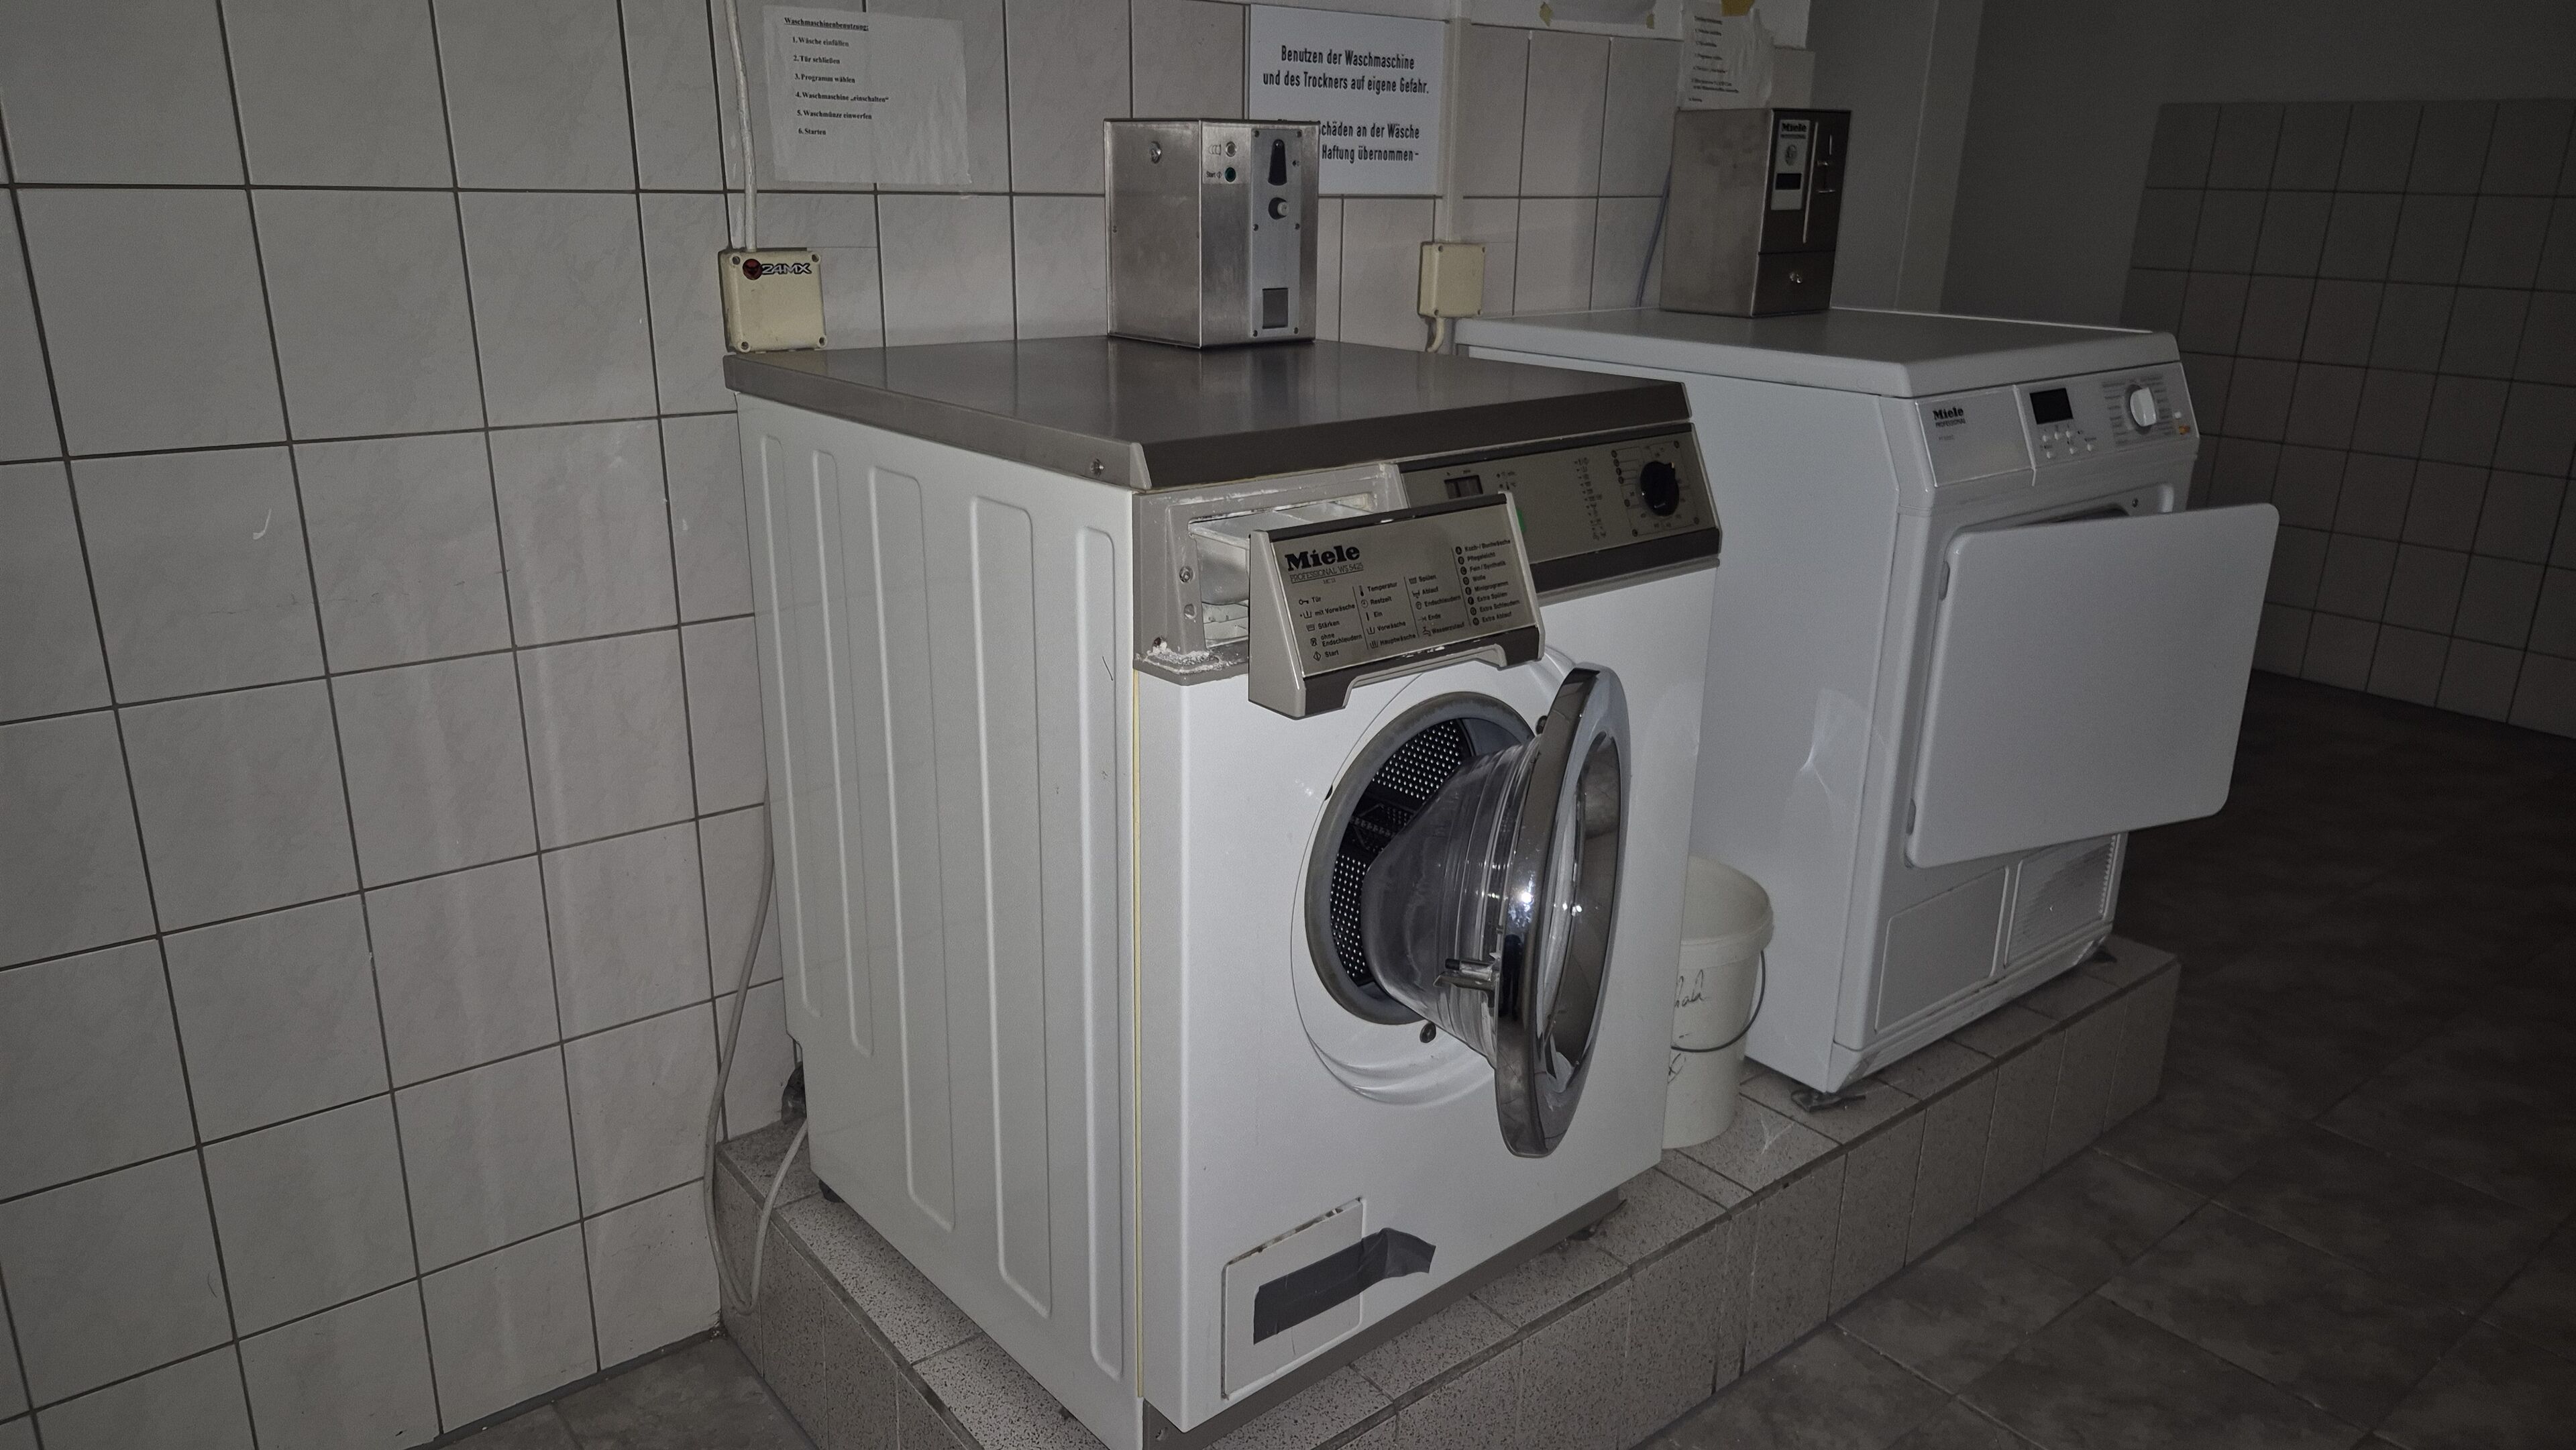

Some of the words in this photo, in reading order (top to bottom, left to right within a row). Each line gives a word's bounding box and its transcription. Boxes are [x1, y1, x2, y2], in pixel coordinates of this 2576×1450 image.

[784, 17, 869, 32] Waschmaschinenbenutzung:
[798, 37, 822, 46] Wäsche
[823, 39, 849, 47] einfüllen
[1281, 45, 1323, 64] Benutzen
[1327, 49, 1342, 65] der
[1345, 50, 1415, 70] Waschmaschine
[801, 74, 833, 82] Programm
[1263, 70, 1281, 86] und
[1284, 70, 1301, 87] des
[1303, 71, 1348, 90] Trockners
[1350, 76, 1365, 91] auf
[1367, 76, 1397, 95] eigene
[1400, 77, 1429, 95] Gefahr.
[802, 92, 849, 101] Waschmaschine
[803, 110, 842, 118] Waschmünze
[1319, 121, 1353, 138] chäden
[1356, 125, 1367, 138] an
[1370, 123, 1385, 139] der
[1387, 123, 1419, 140] Wäsche
[1782, 123, 1807, 132] Miele
[1322, 144, 1354, 164] Haftung
[1933, 407, 1964, 420] Miele
[1285, 546, 1360, 572] Miele
[1289, 568, 1337, 582] PROFESSIONAL
[1367, 582, 1397, 592] Temperatur
[1371, 596, 1392, 605] Restzeit
[1325, 604, 1355, 614] Vorwäsche
[1318, 621, 1340, 629] Stärken
[1377, 621, 1406, 631] Vorwäsche
[1322, 634, 1362, 647] Endschleudern
[1380, 634, 1416, 645] Hauptwäsche
[1325, 650, 1339, 658] Start
